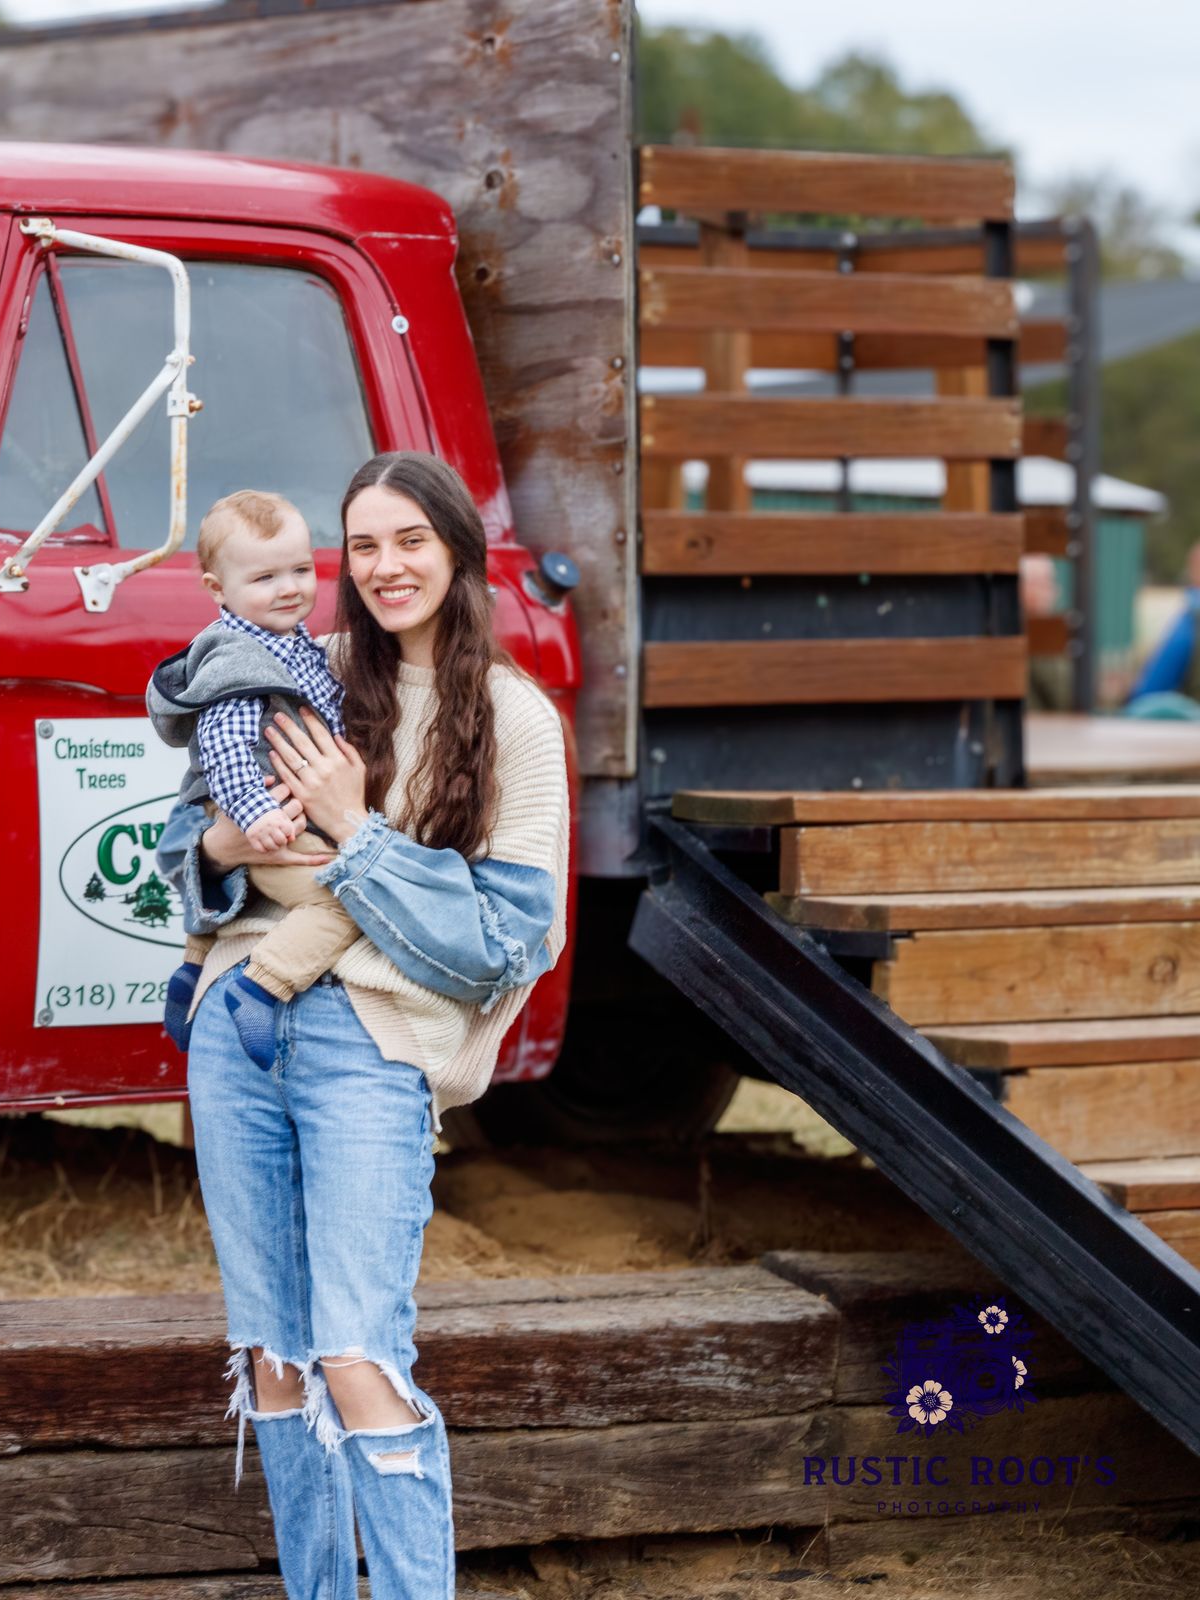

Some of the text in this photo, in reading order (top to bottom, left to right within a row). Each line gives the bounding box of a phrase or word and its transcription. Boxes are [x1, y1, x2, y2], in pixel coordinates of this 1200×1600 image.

[54, 737, 145, 760] Christmas
[75, 767, 127, 789] Trees
[46, 983, 116, 1011] (318)
